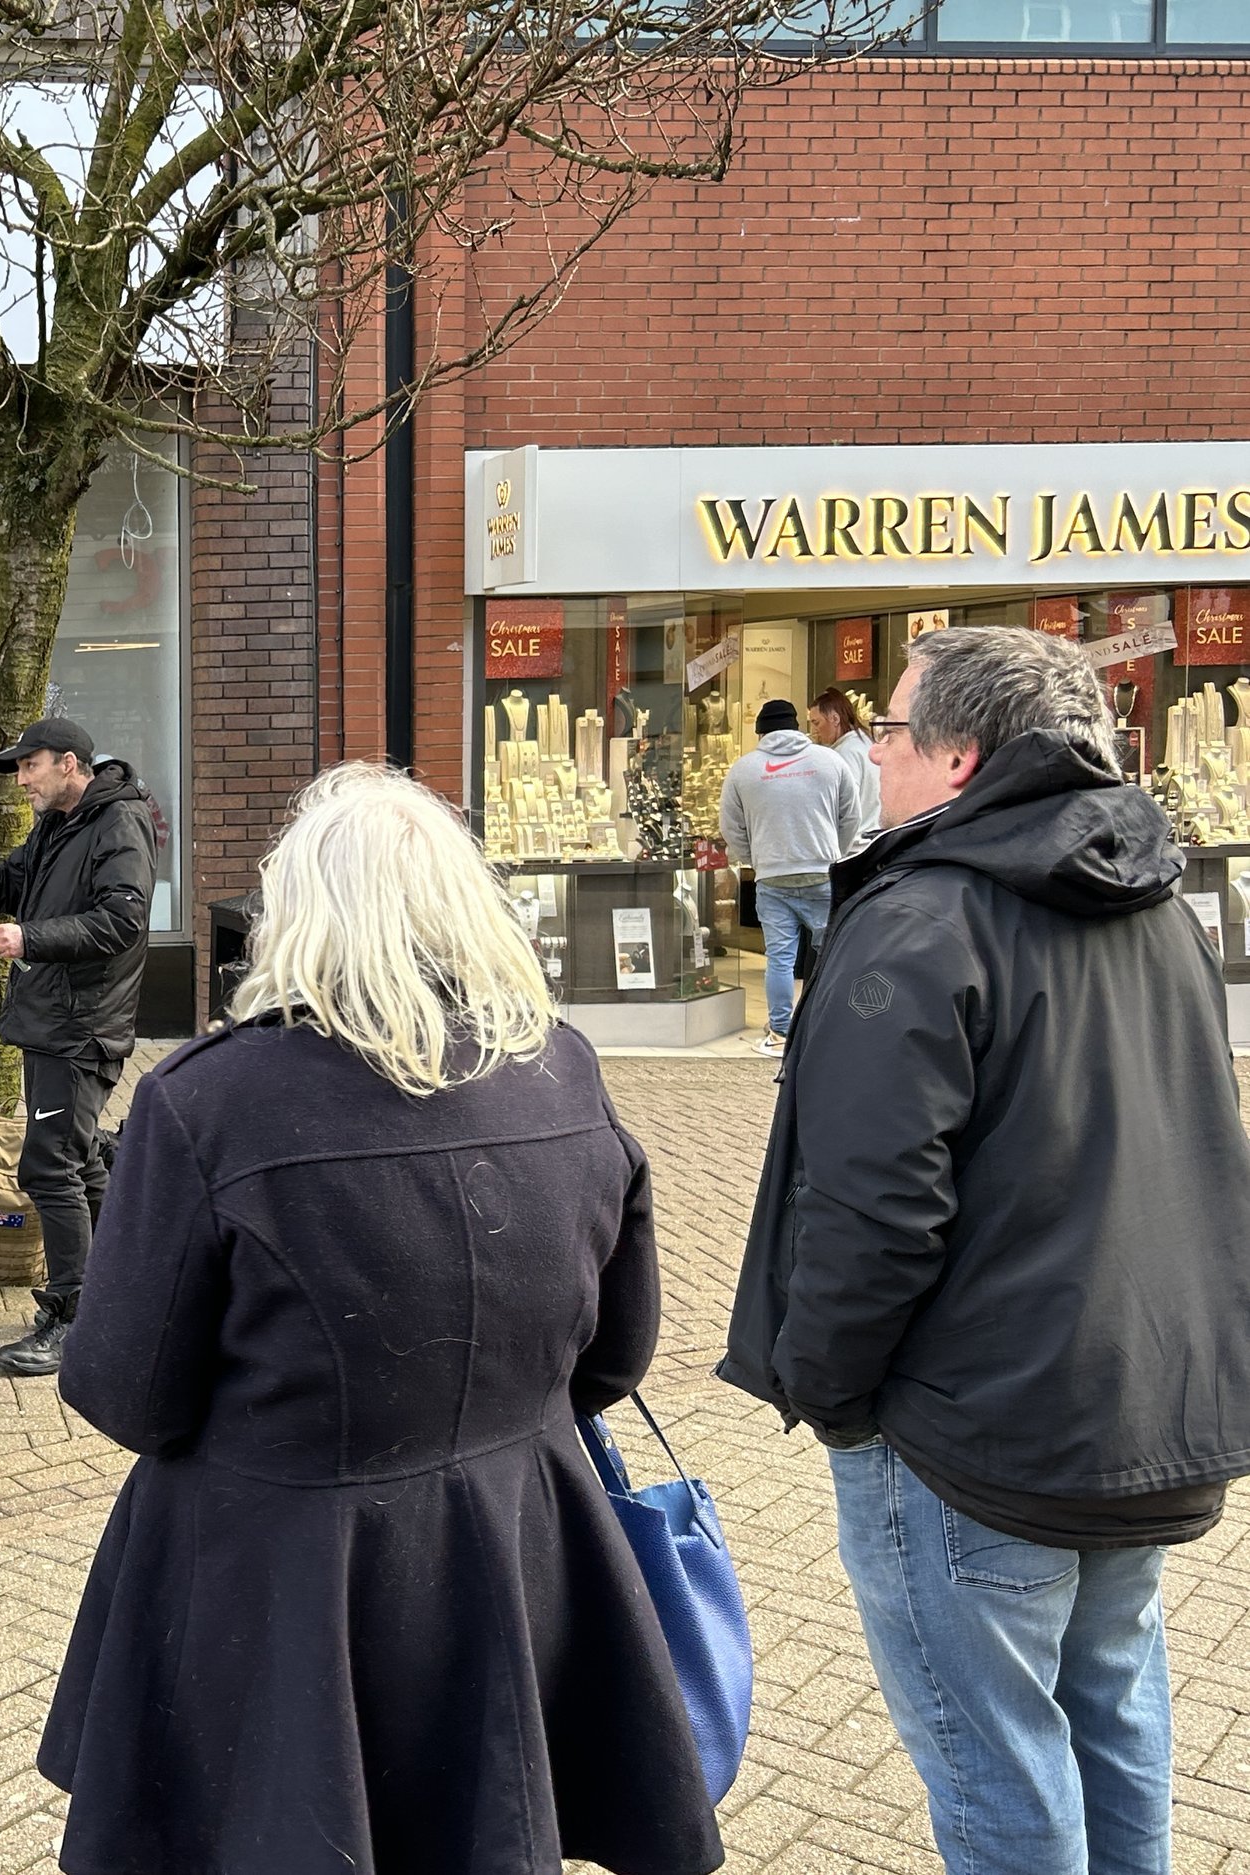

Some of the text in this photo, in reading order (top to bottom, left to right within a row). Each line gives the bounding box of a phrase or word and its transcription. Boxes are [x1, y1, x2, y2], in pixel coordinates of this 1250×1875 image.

[486, 511, 521, 538] WARREN
[699, 491, 1250, 562] WARREN JAMES
[490, 534, 517, 561] JAMES
[1195, 608, 1244, 625] Christmas
[490, 620, 542, 637] Christmas
[1197, 627, 1243, 645] SALE
[490, 638, 541, 657] SALE
[1112, 633, 1152, 654] SALE
[843, 649, 863, 664] SALE
